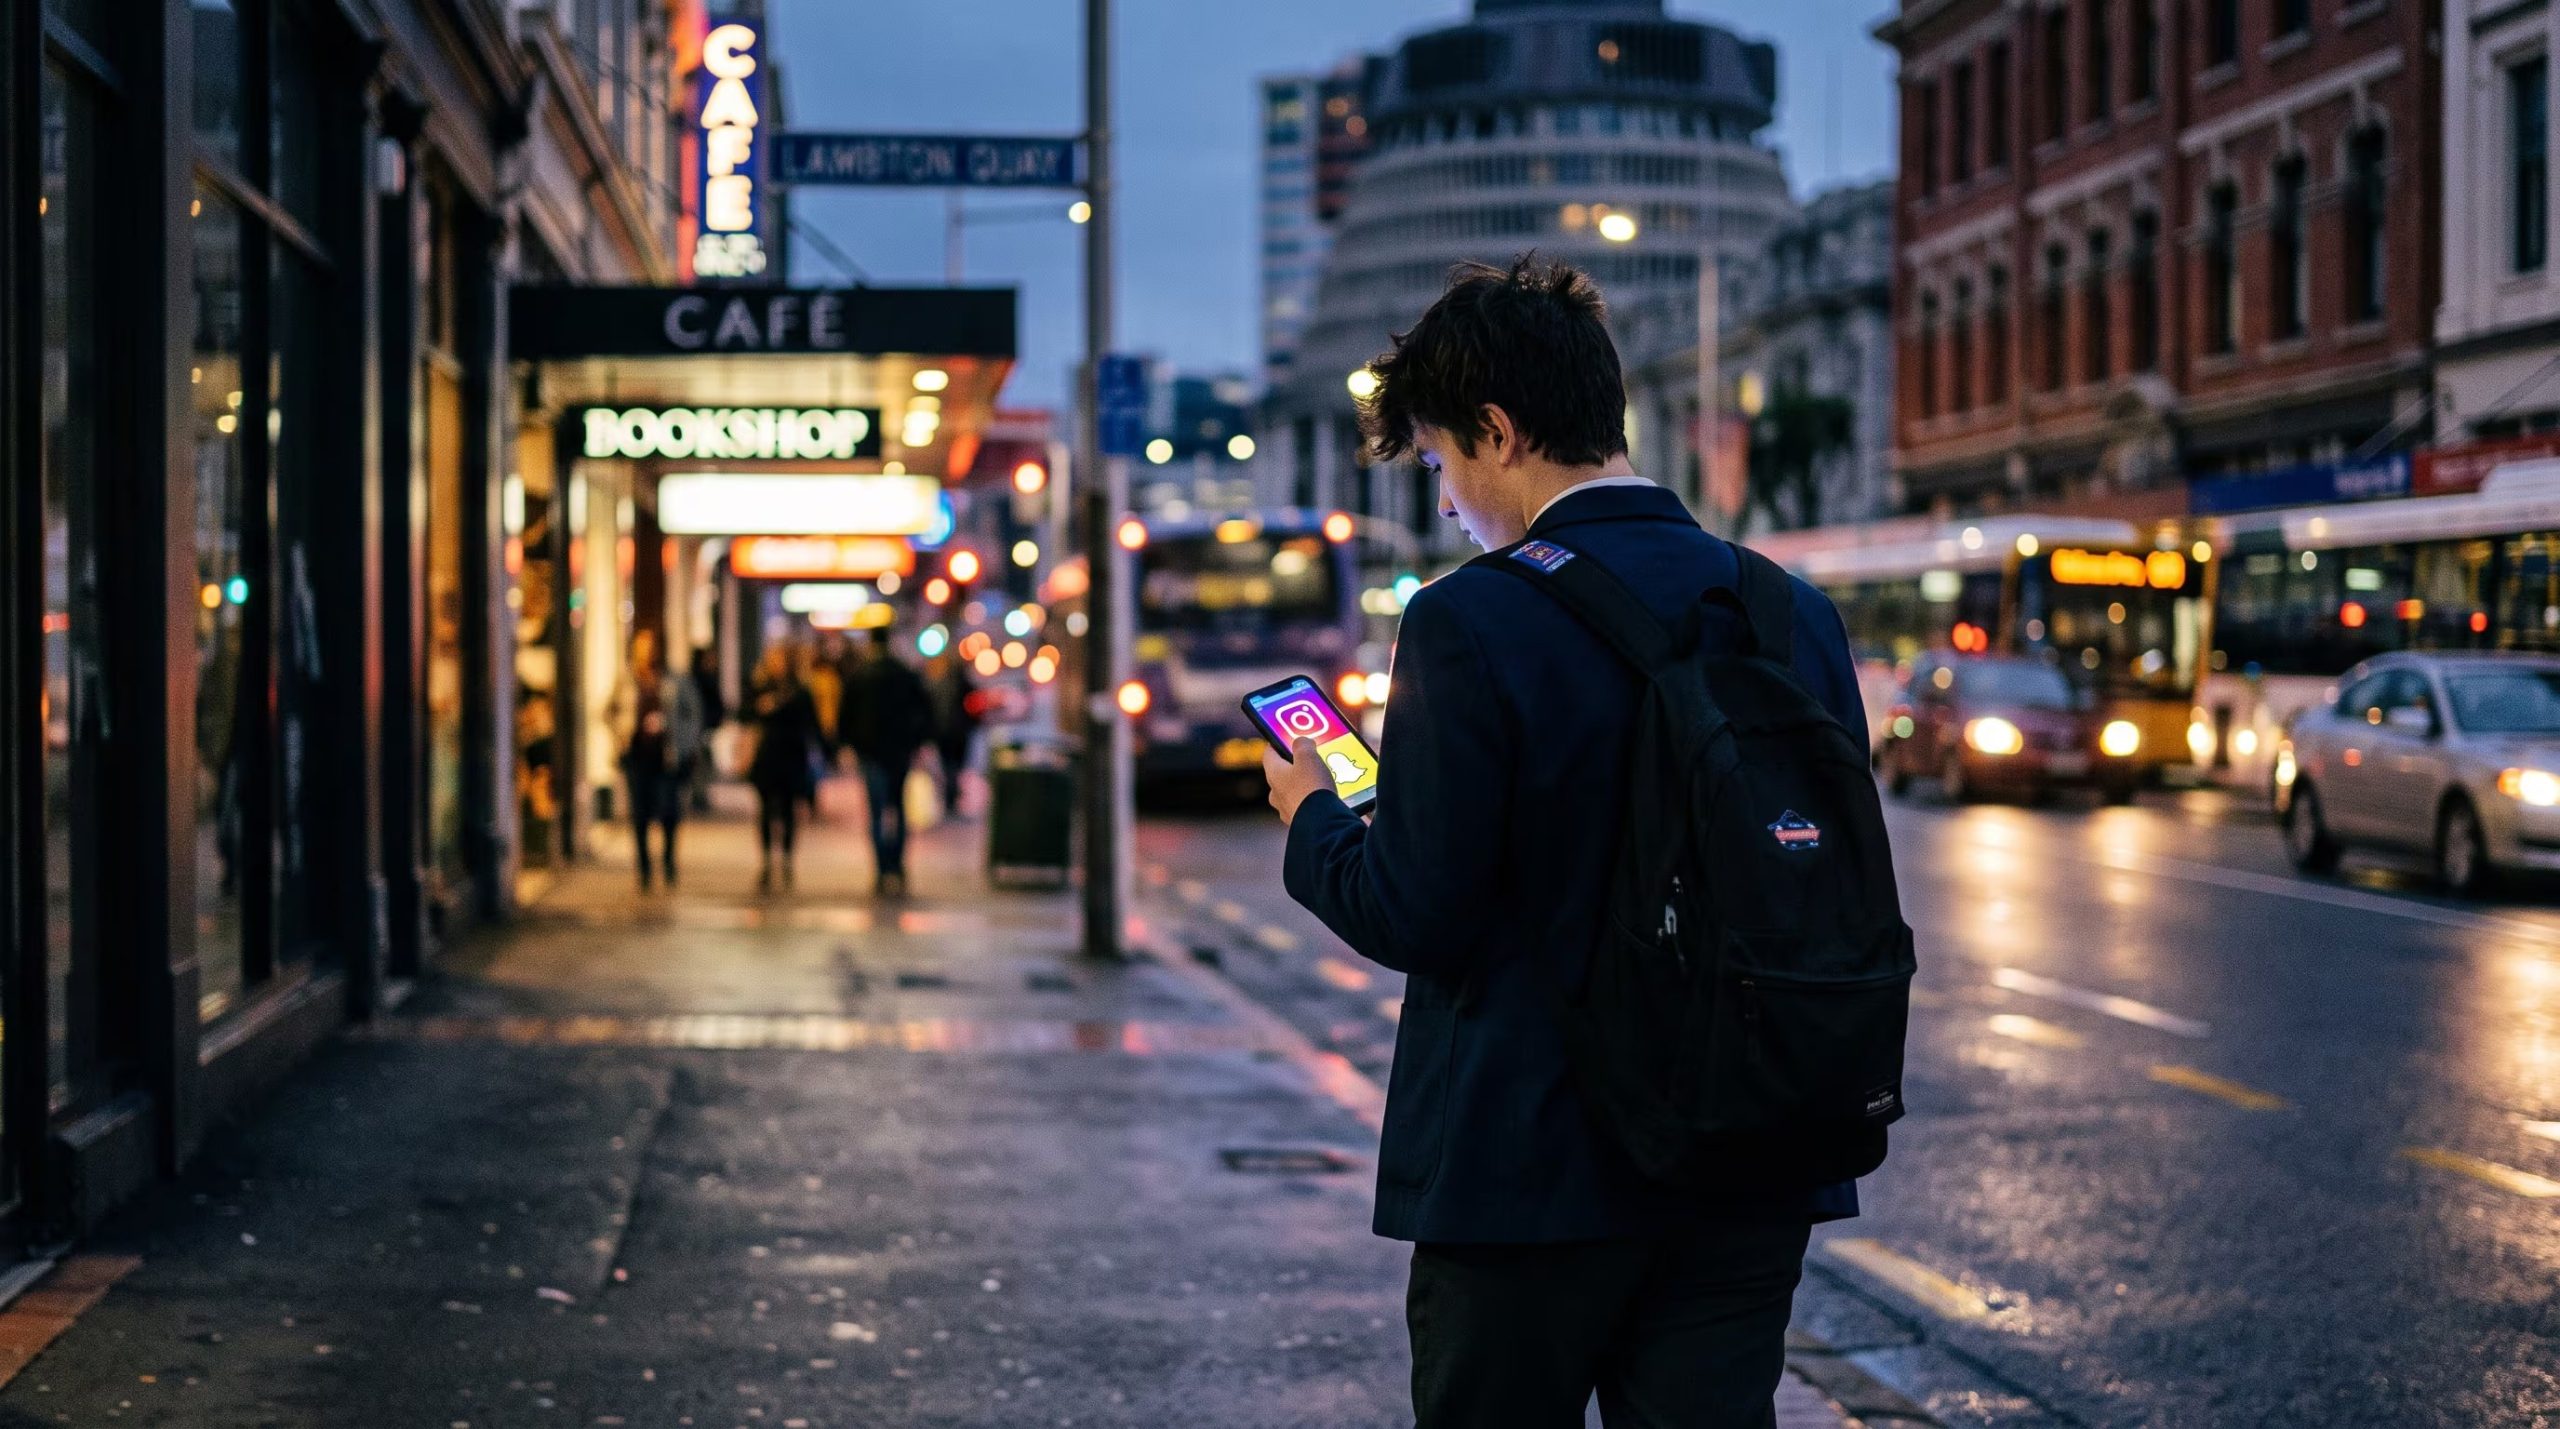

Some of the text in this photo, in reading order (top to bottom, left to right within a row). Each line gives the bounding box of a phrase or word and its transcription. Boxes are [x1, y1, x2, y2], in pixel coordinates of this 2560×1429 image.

[701, 24, 759, 231] CAFE
[967, 144, 1060, 180] QUAY
[583, 408, 869, 459] BOOKSHOP
